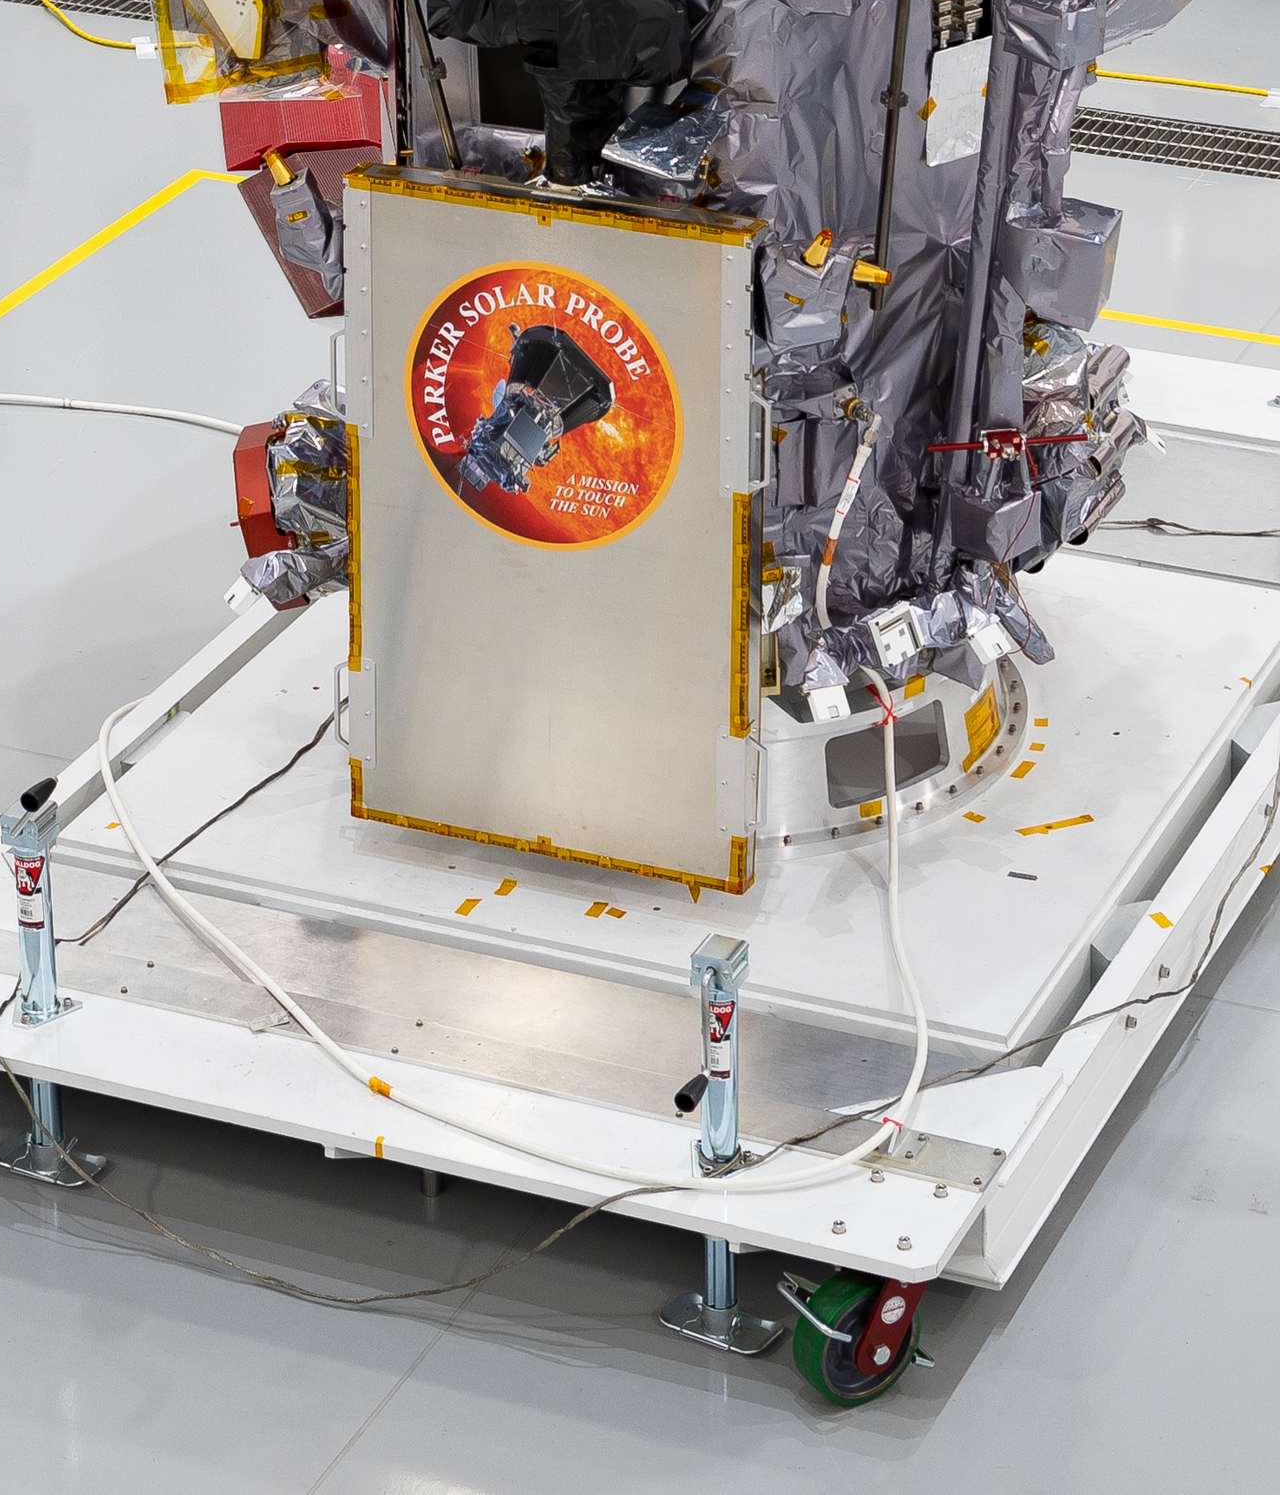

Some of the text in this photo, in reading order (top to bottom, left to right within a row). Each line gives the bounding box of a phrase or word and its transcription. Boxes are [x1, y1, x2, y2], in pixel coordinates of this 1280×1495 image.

[423, 283, 651, 447] PARKER SOLAR PROBE
[566, 473, 639, 496] A MISSION
[556, 485, 626, 508] TO TOUCH
[550, 498, 611, 519] THE SUN
[710, 1006, 732, 1014] LDOG
